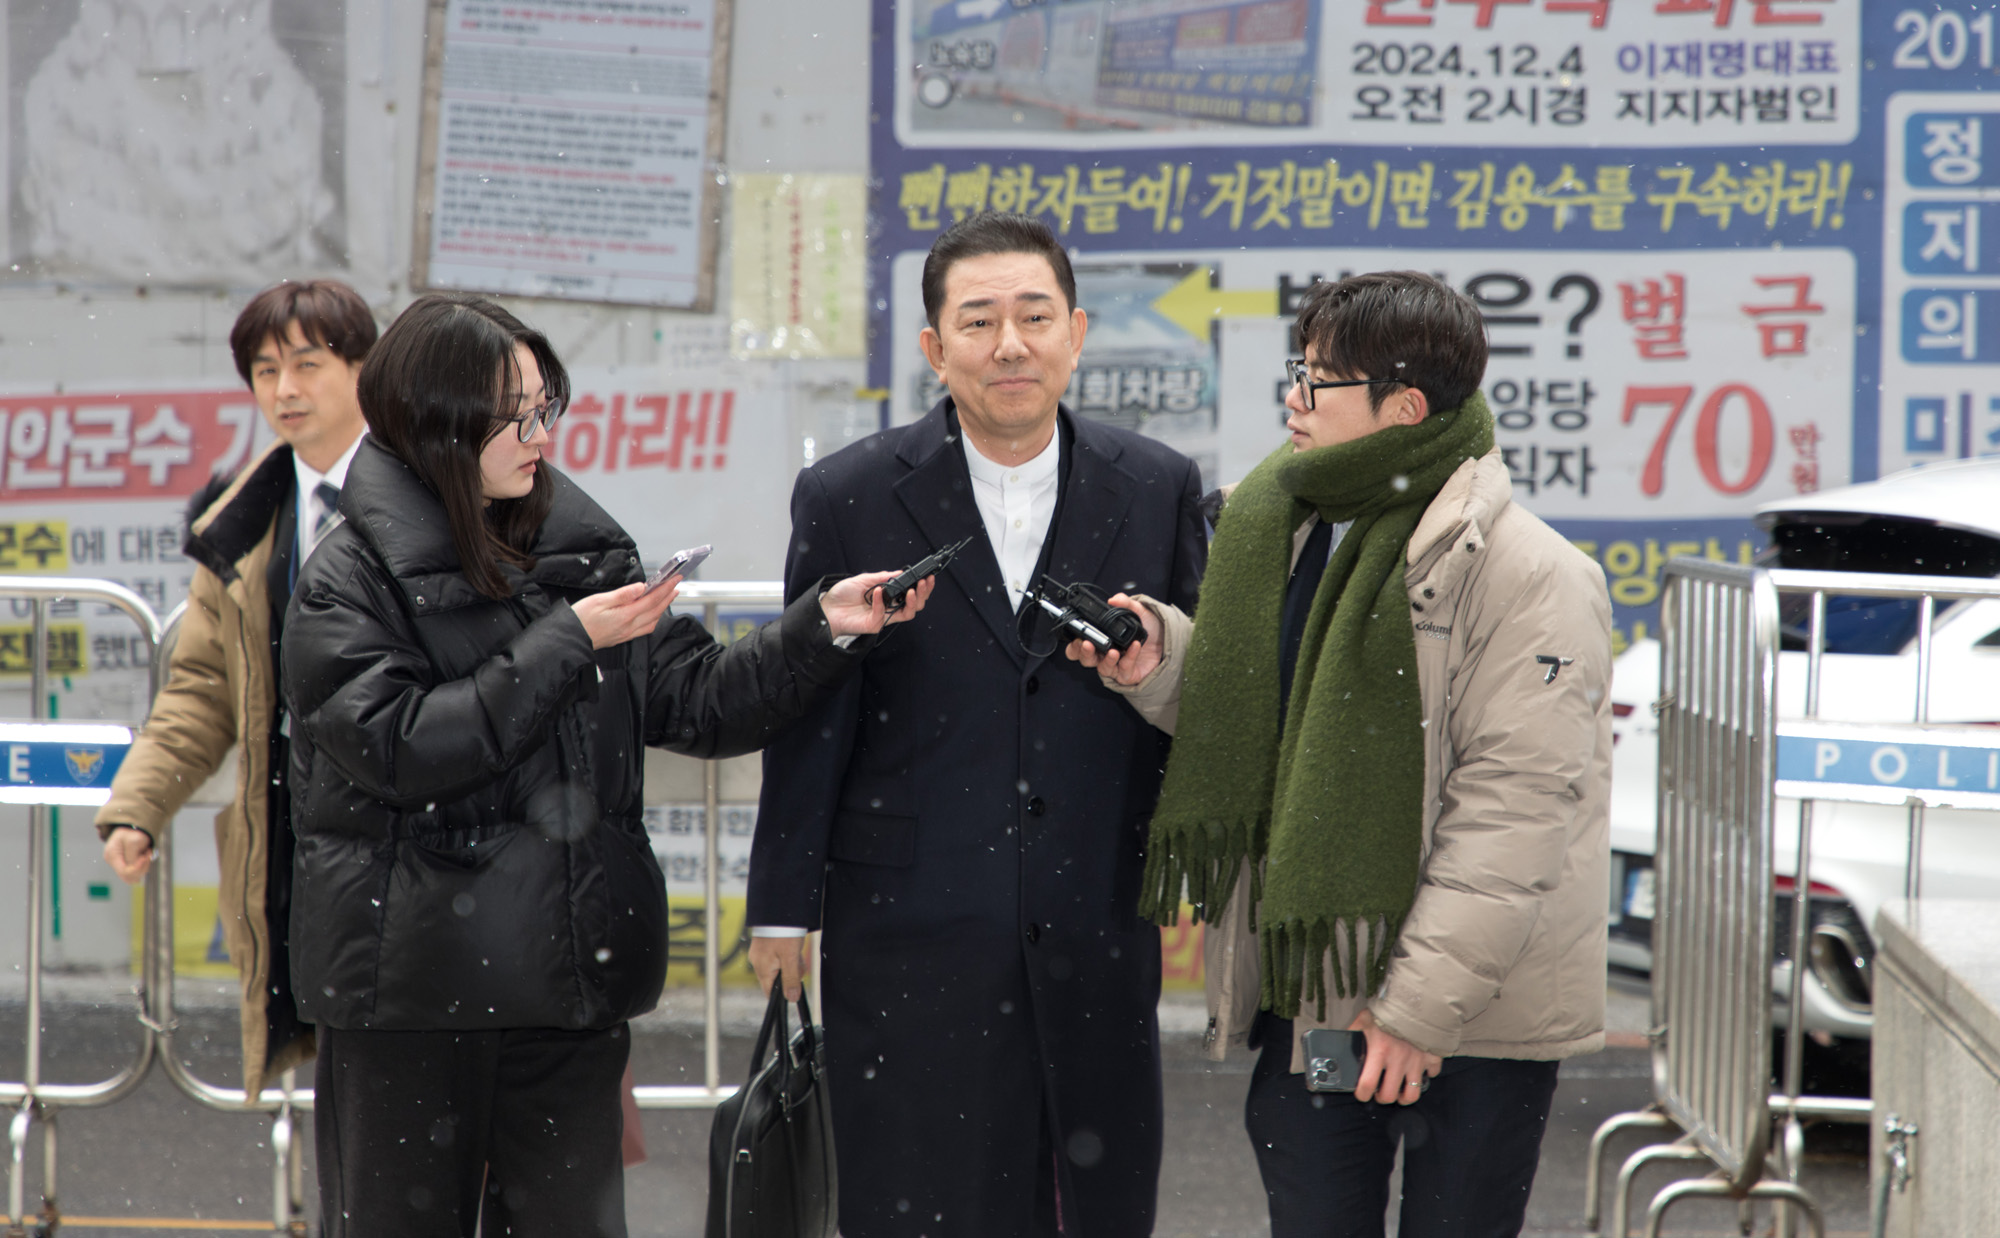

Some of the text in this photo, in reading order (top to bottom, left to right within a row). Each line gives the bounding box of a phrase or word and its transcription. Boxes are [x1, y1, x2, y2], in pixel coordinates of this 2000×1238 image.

[1351, 41, 1840, 79] 2024.12.4 이재명대표
[1351, 85, 1446, 124] 오전
[1467, 86, 1589, 125] 2시경
[1616, 86, 1839, 125] 지지자범인
[1922, 117, 1982, 184] 정
[1201, 159, 1434, 232] 거짓말이면
[1448, 160, 1636, 232] 김용수를
[1647, 160, 1854, 232] 구속하라!
[1920, 206, 1980, 272] 지
[1617, 273, 1825, 361] 벌 금
[1917, 293, 1978, 359] 의
[0, 403, 192, 492] 안군수
[537, 388, 735, 474] 하라!!
[1621, 383, 1775, 497] 70
